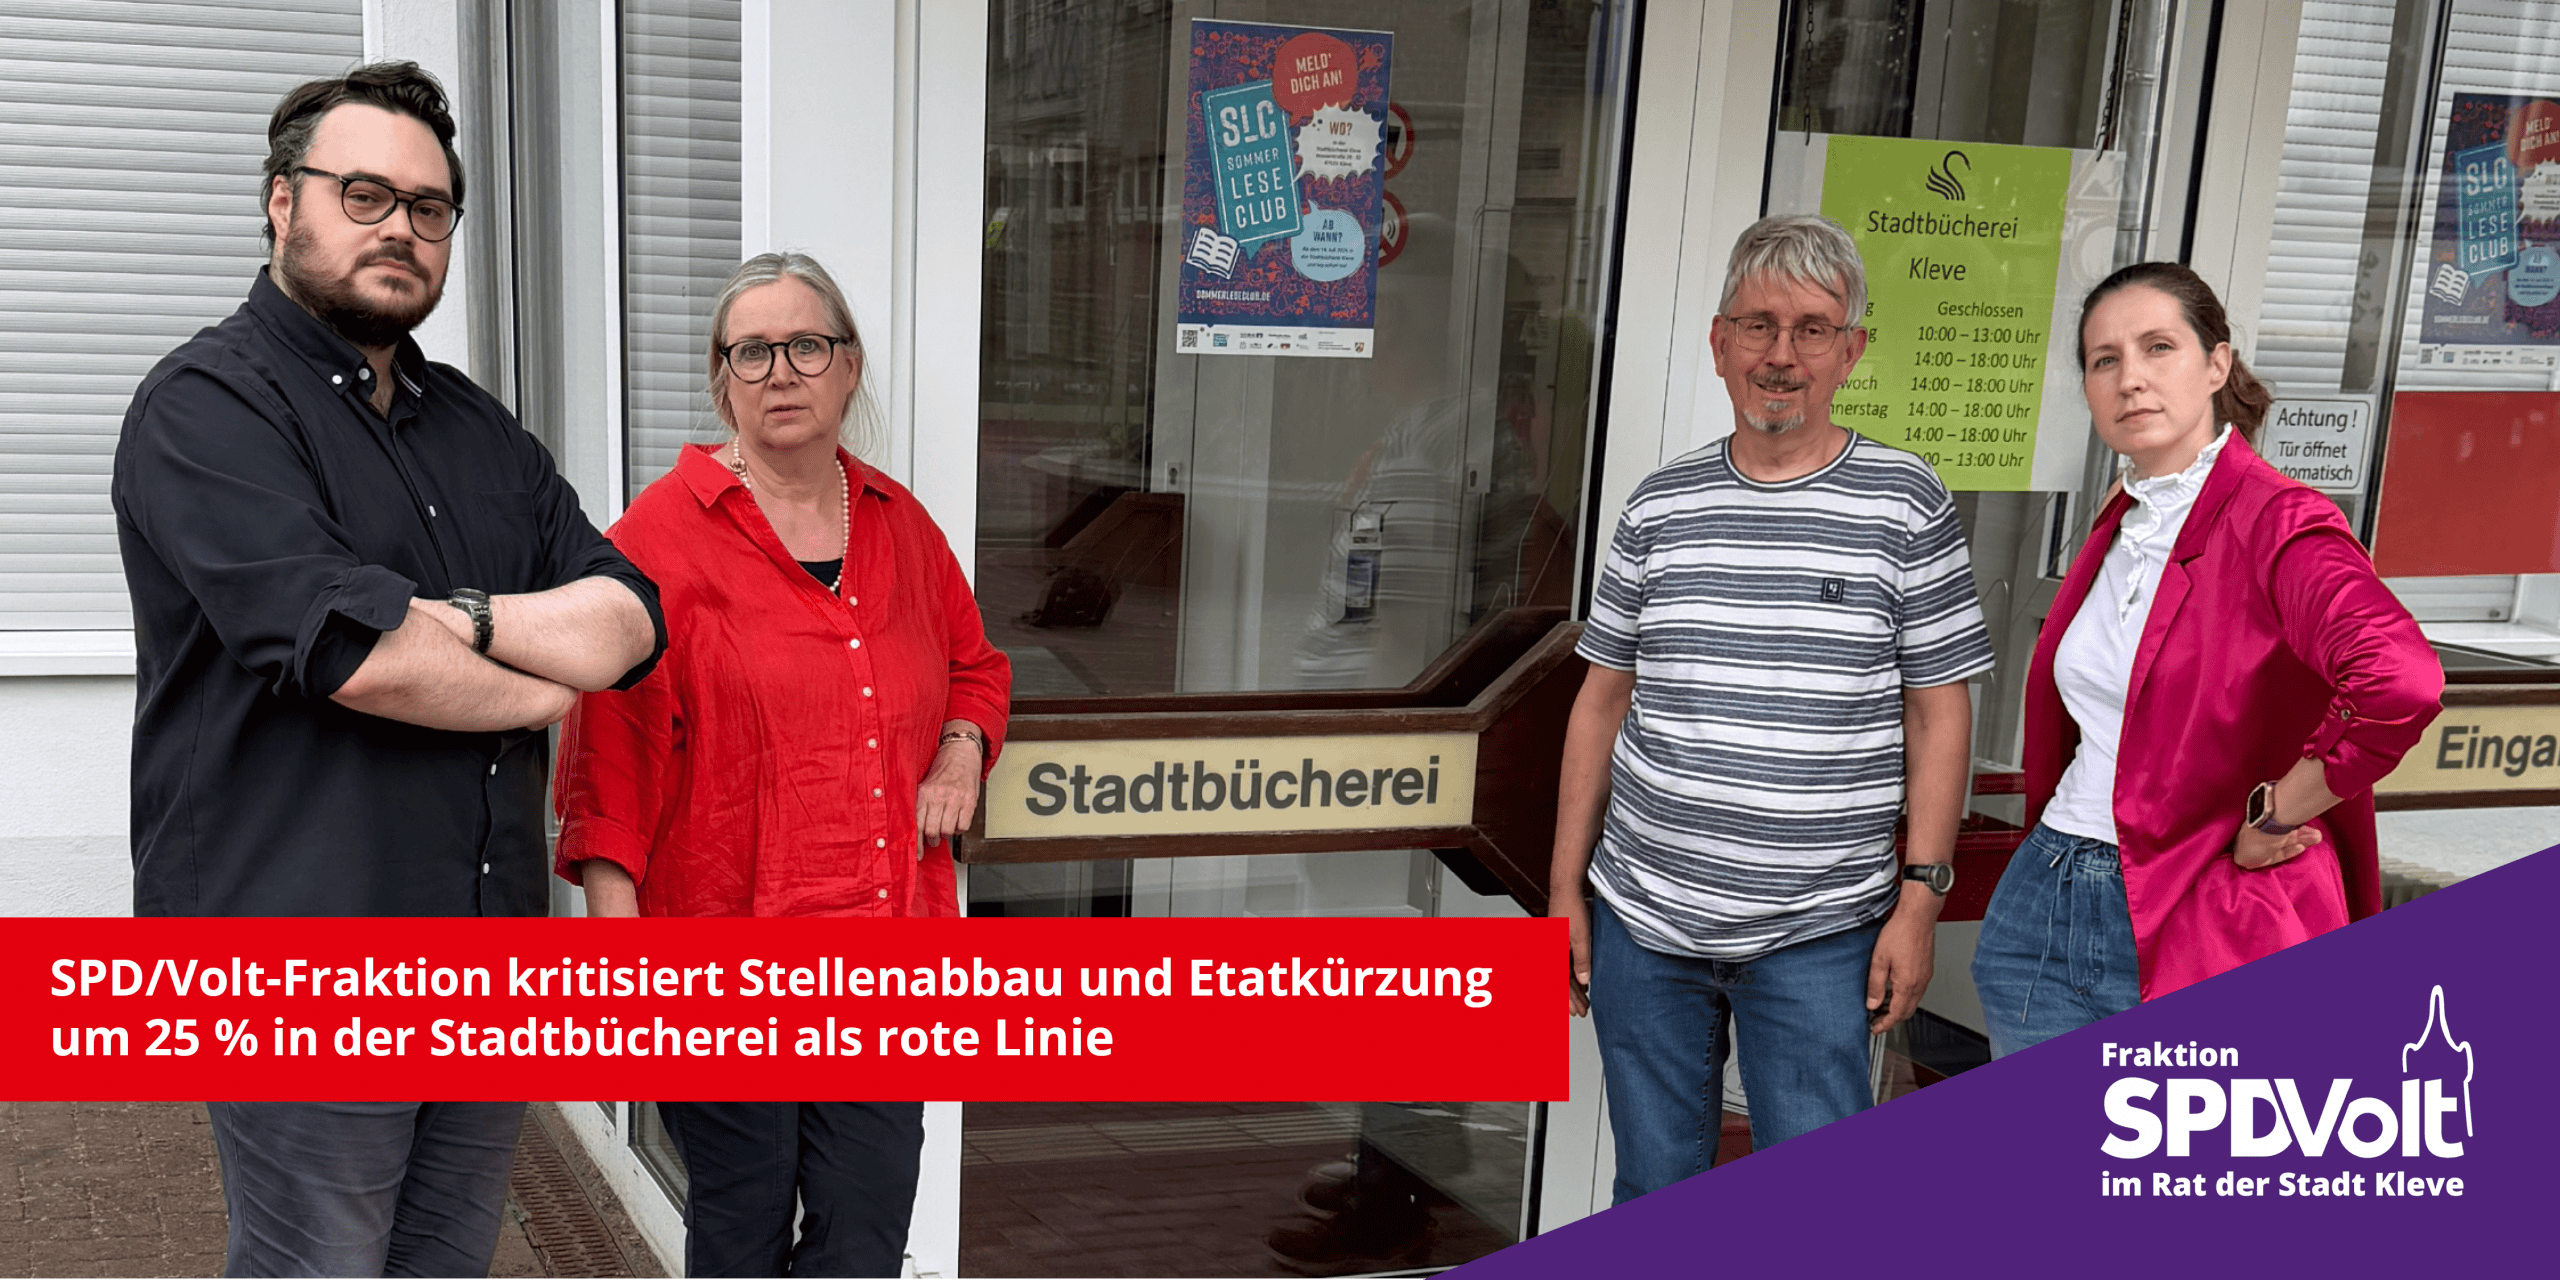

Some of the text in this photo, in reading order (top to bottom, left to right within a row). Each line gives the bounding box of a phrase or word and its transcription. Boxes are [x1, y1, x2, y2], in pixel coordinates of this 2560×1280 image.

[1296, 53, 1332, 74] MELD'
[1290, 70, 1343, 94] DICH AN!
[1220, 100, 1276, 147] SLC
[1329, 121, 1353, 136] WO?
[1227, 148, 1280, 171] SOMMER
[1231, 167, 1283, 199] LESE
[2466, 157, 2507, 196] SLC
[1235, 197, 1286, 228] CLUB
[1867, 210, 2019, 239] Stadtbücherei
[2468, 211, 2508, 240] LESE
[1313, 231, 1343, 243] WANN?
[2469, 236, 2508, 263] CLUB
[1909, 257, 1966, 282] Kleve
[1937, 300, 2024, 319] Geschlossen
[1917, 326, 1957, 342] 10:00
[1973, 327, 2012, 344] 13:00
[2015, 328, 2042, 344] Uhr
[1914, 351, 1953, 368] 14:00
[1970, 352, 2009, 369] 18:00
[2012, 353, 2038, 369] Uhr
[1910, 376, 1950, 392] 14:00
[1966, 378, 2005, 393] 18:00
[2009, 378, 2035, 394] Uhr
[1907, 401, 1947, 418] 14:00
[1963, 402, 2003, 418] 18:00
[2006, 403, 2032, 419] Uhr
[2276, 407, 2358, 433] Achtung !
[1903, 426, 1943, 442] 14:00
[1960, 427, 1999, 443] 18:00
[2002, 427, 2028, 443] Uhr
[1957, 452, 1996, 468] 13:00
[1998, 452, 2025, 468] Uhr
[2279, 441, 2347, 459] Tür öffnet
[2436, 725, 2560, 777] Einga
[1025, 755, 1440, 816] Stadtbücherei
